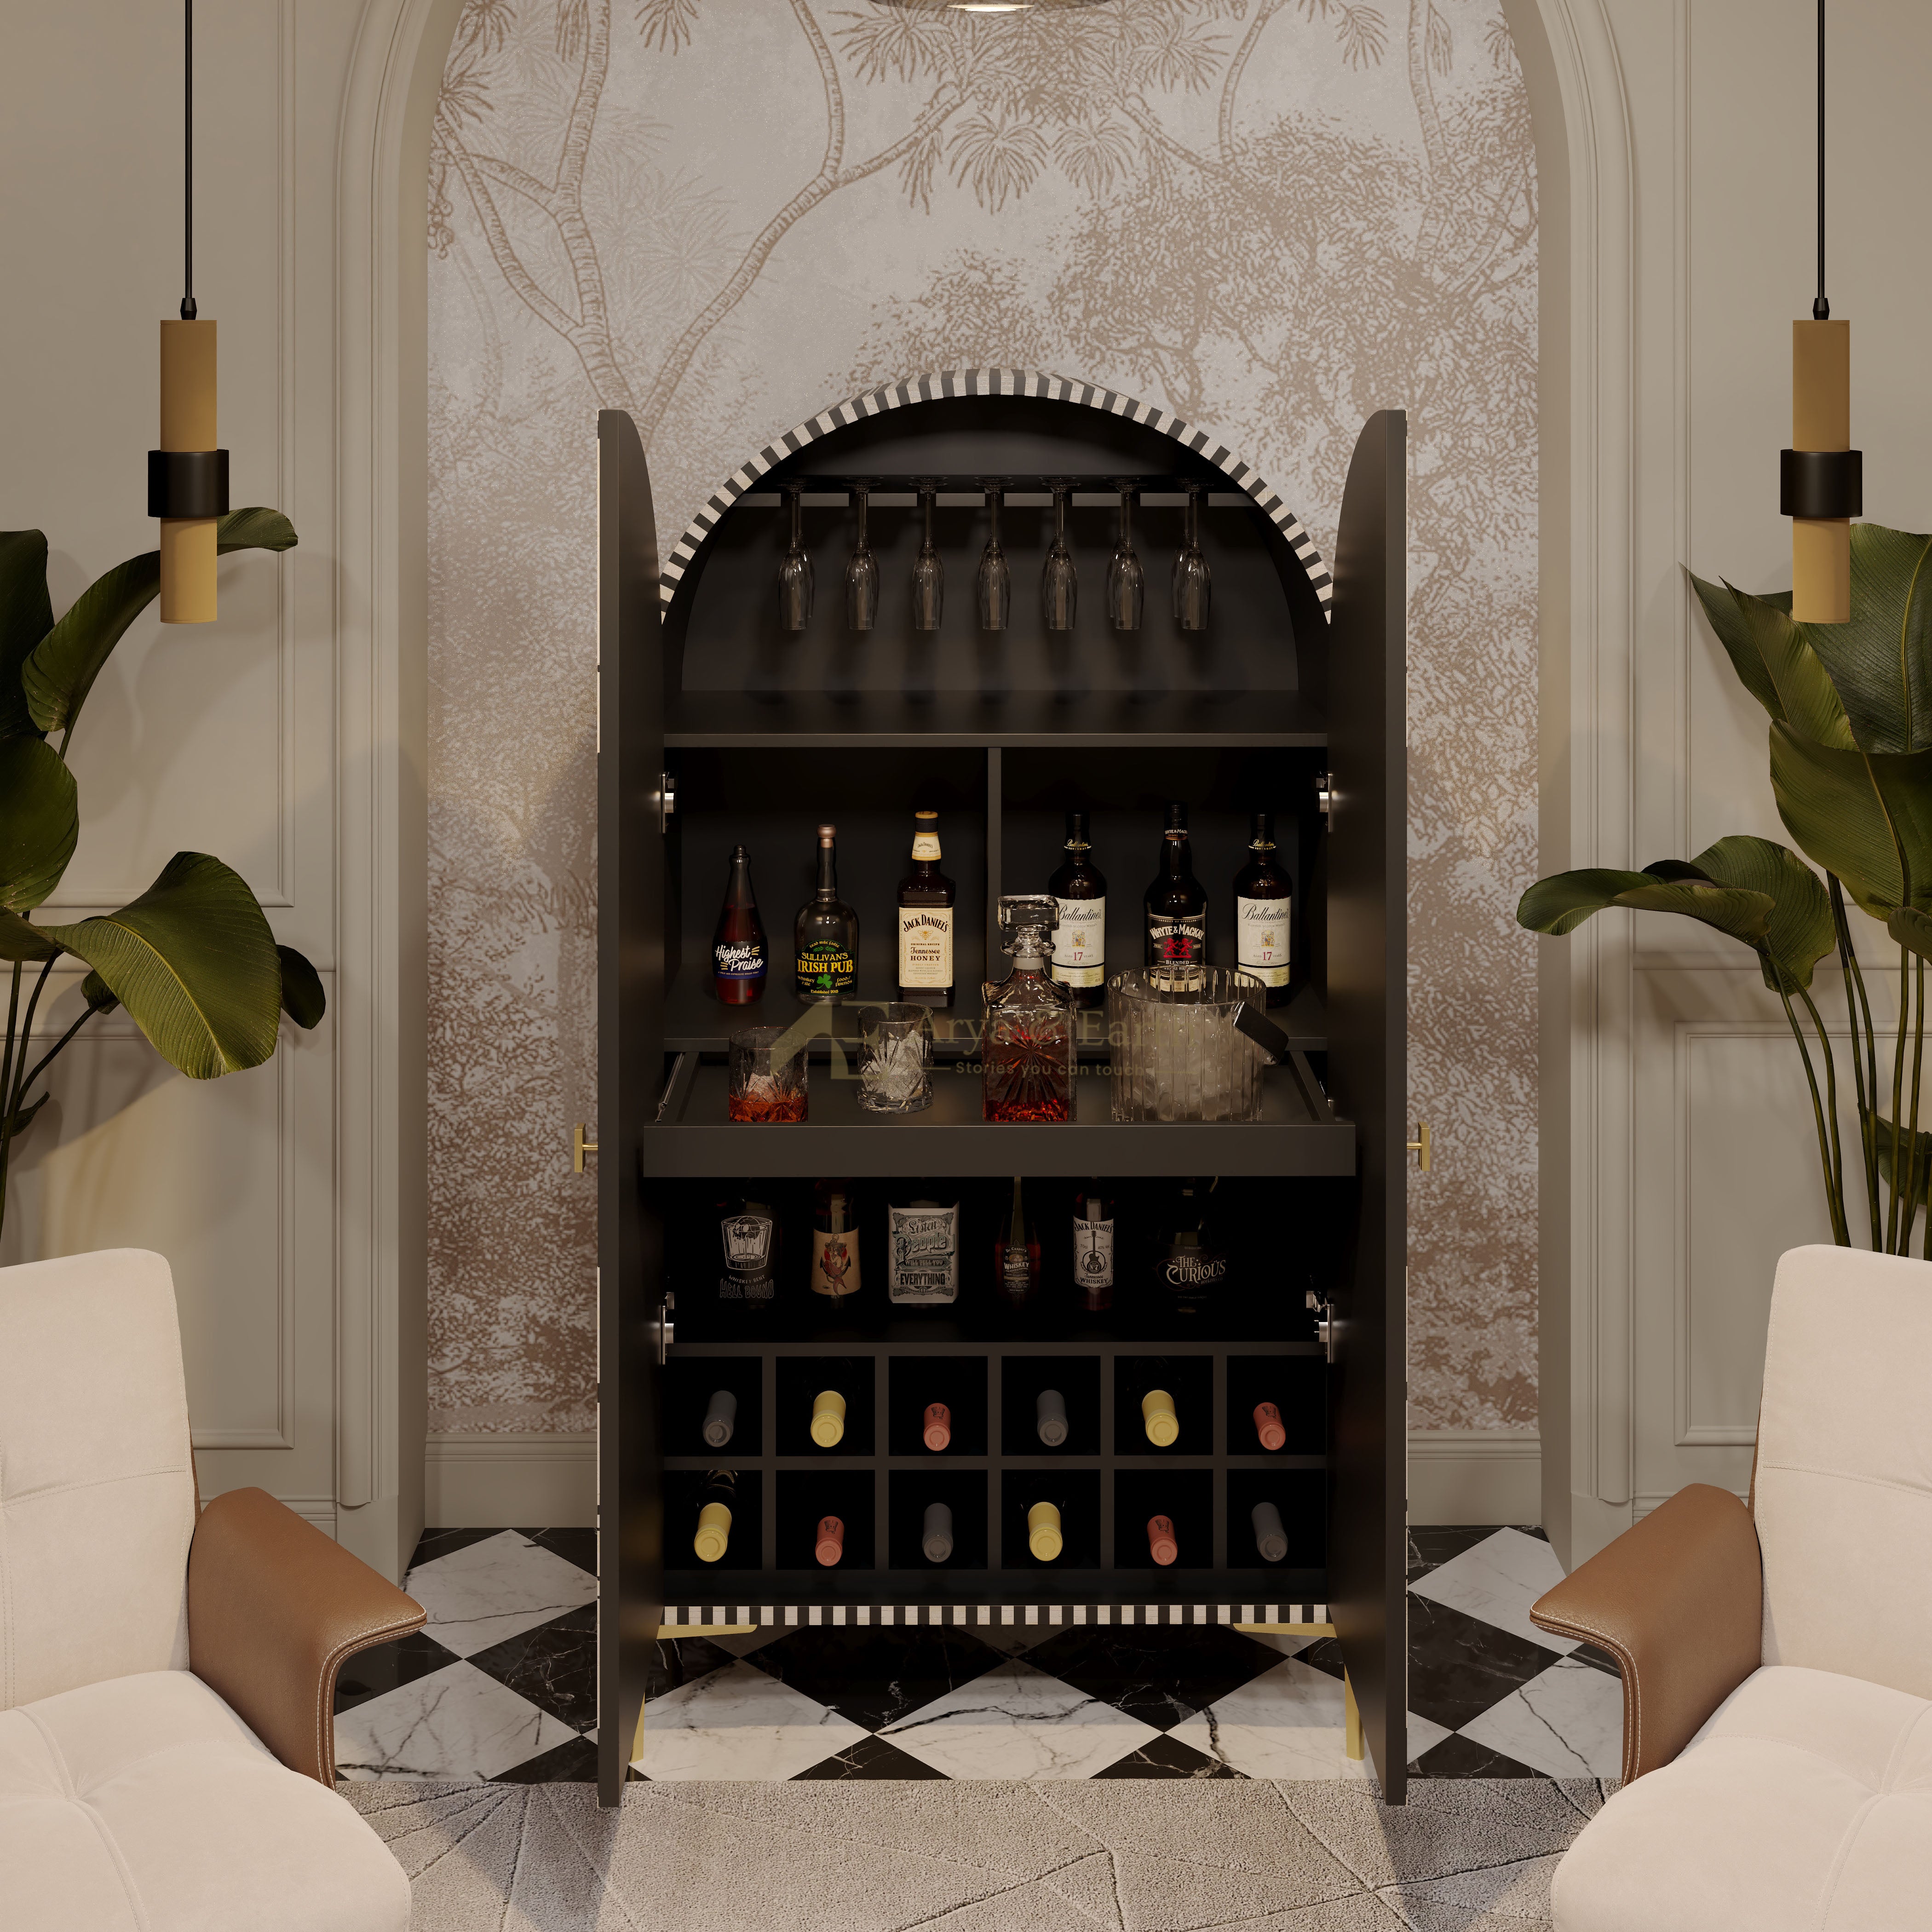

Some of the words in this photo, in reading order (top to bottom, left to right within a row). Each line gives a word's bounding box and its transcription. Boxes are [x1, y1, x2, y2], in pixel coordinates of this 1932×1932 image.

[1242, 903, 1289, 921] Ballantine's
[903, 917, 921, 932] JACK
[921, 914, 949, 932] DANIEL'S
[1150, 926, 1173, 939] WHYTE
[1179, 924, 1204, 940] MACKAY
[715, 944, 751, 962] Highest
[801, 952, 848, 961] SULLIVAN'S
[1073, 952, 1083, 960] 17
[1262, 952, 1272, 960] 17
[728, 958, 764, 972] Praise
[797, 959, 828, 973] IRISH
[830, 960, 854, 973] PUB
[908, 1219, 937, 1235] Listen
[1074, 1221, 1090, 1231] JACK
[1090, 1221, 1113, 1234] DANIEL'S
[892, 1231, 947, 1266] People
[1175, 1255, 1196, 1268] THE
[729, 1275, 751, 1284] WHISKEY
[753, 1274, 765, 1282] BENT
[900, 1273, 945, 1285] EVERYTHING
[719, 1278, 743, 1298] HELL
[745, 1279, 774, 1299] BOUND
